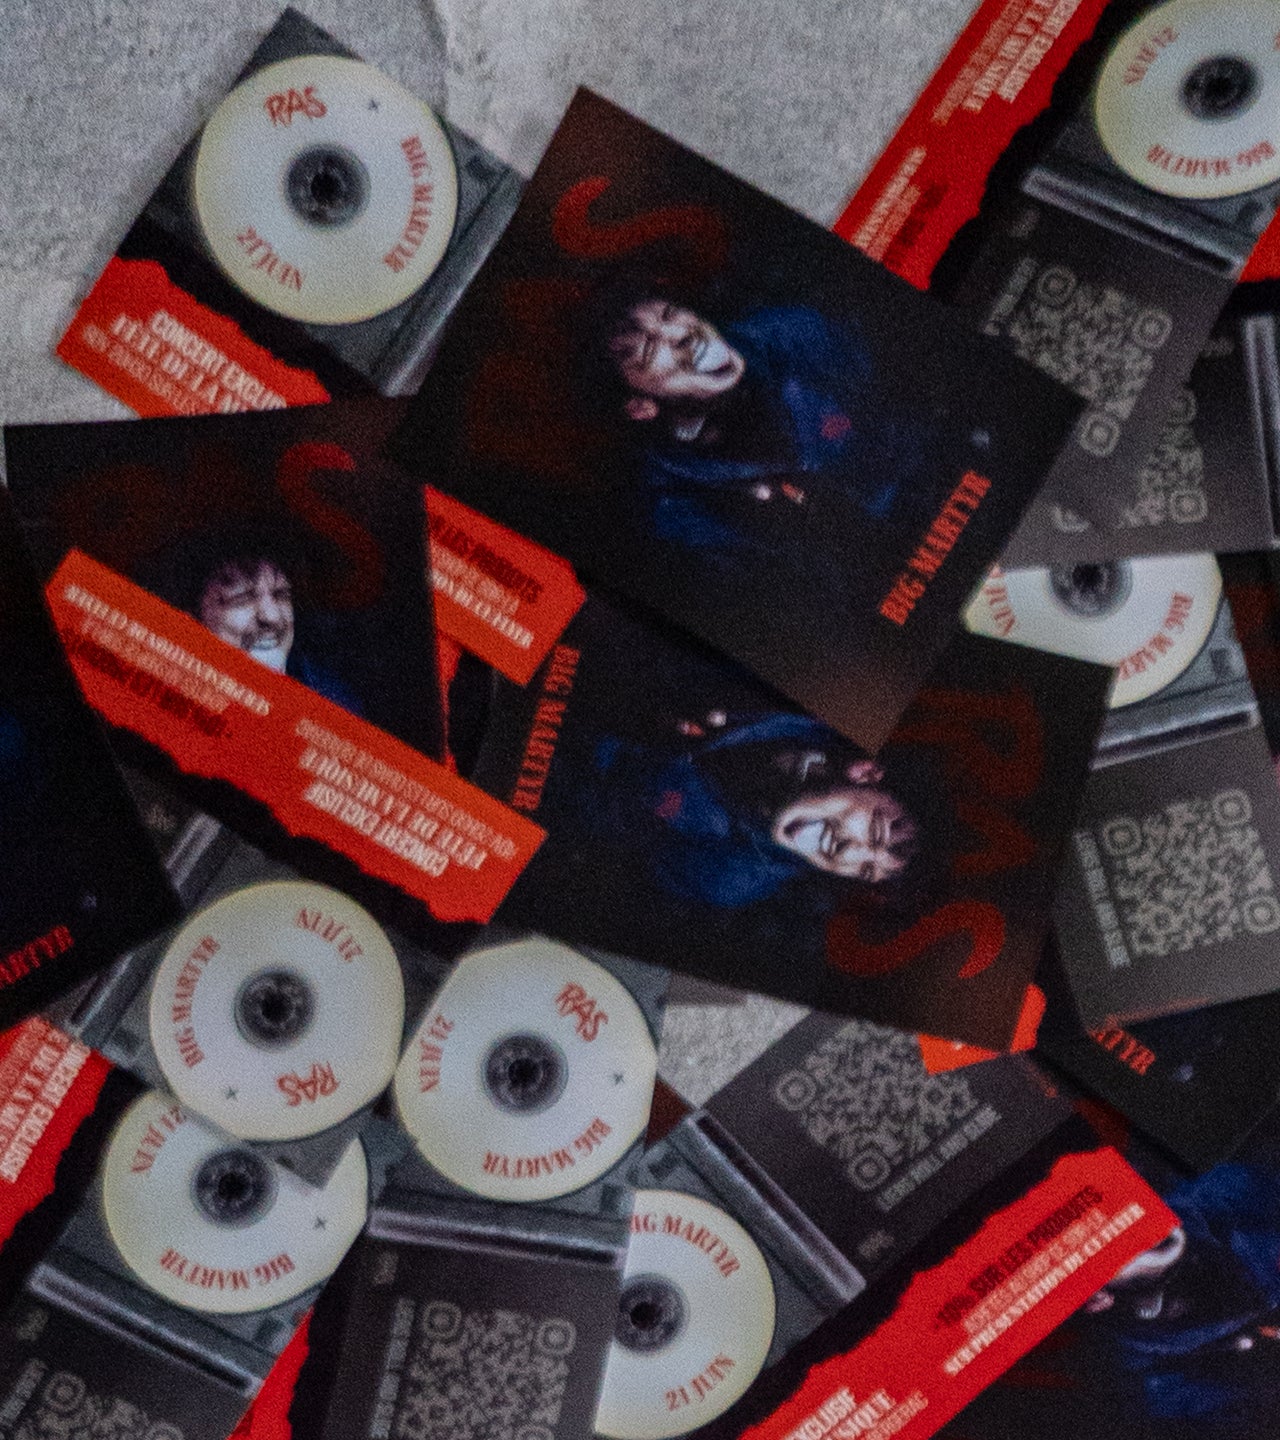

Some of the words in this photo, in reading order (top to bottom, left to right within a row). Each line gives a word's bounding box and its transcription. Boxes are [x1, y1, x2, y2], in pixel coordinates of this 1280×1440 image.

[263, 84, 328, 126] RAS
[400, 134, 428, 180] BIG
[382, 182, 433, 272] MARTYR
[235, 226, 269, 256] 21
[253, 244, 304, 290] JUIN
[876, 570, 928, 627] BIG
[904, 465, 994, 580] MARTYR
[295, 907, 346, 942] JUIN
[337, 936, 362, 961] 21
[170, 935, 219, 1024] MARTYR
[426, 1015, 453, 1040] 21
[554, 981, 609, 1043] RAS
[175, 1027, 205, 1069] BIG
[418, 1039, 442, 1094] JUIN
[274, 1062, 340, 1108] RAS
[572, 1116, 612, 1153] BIG
[481, 1147, 575, 1179] MARTYR
